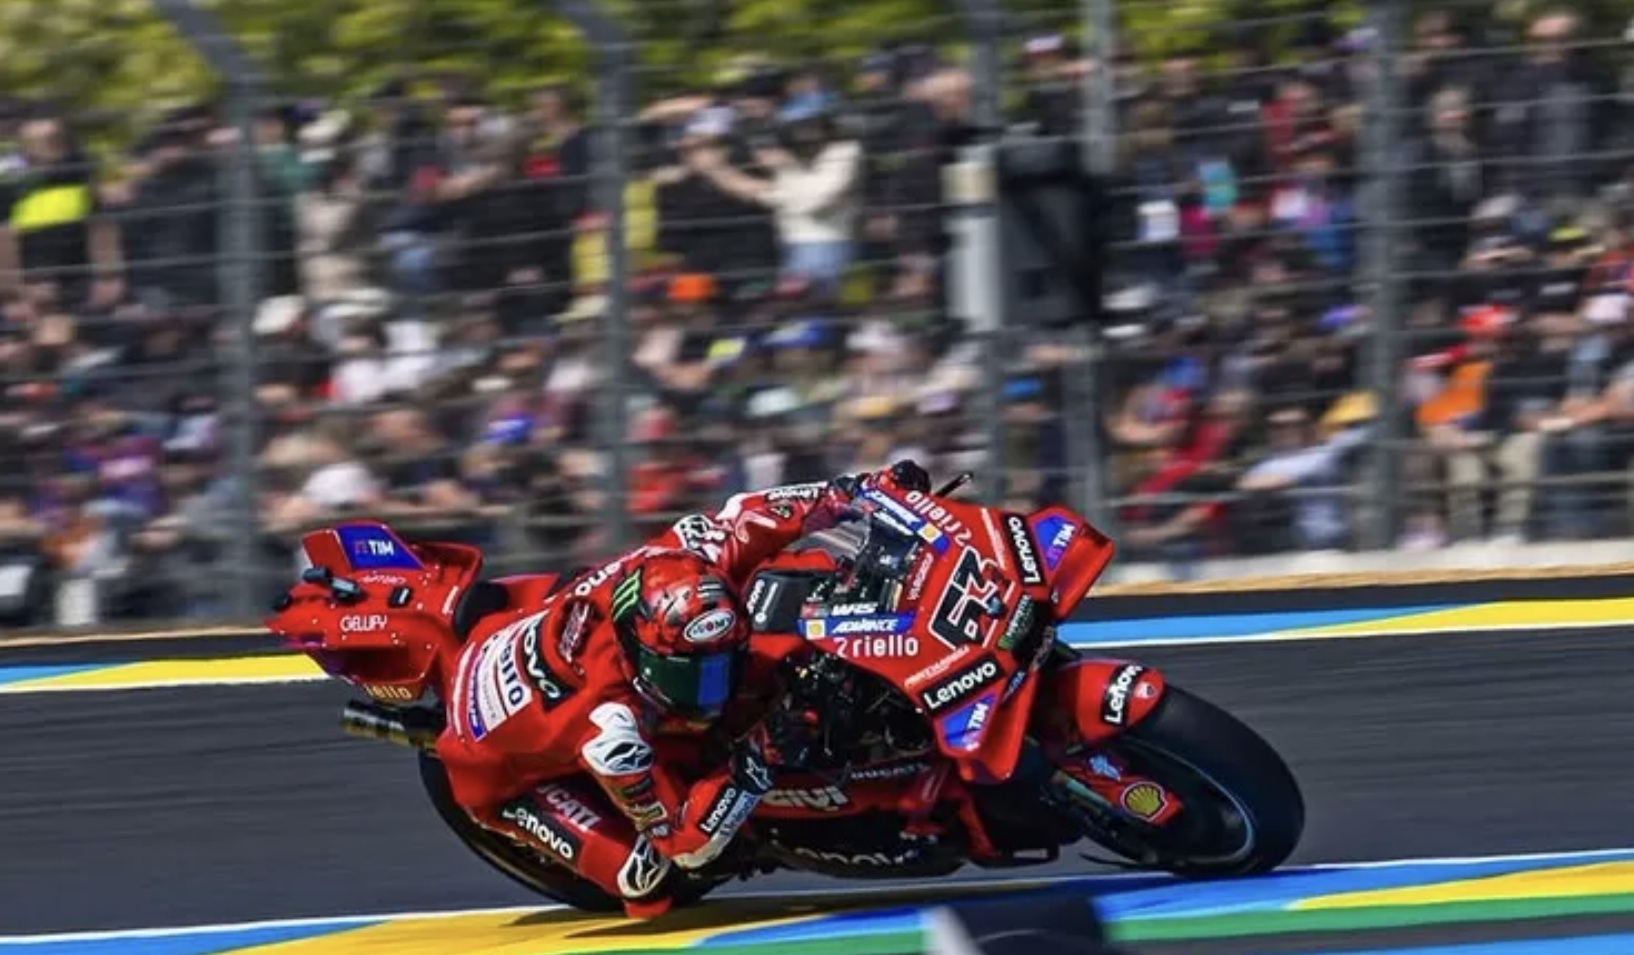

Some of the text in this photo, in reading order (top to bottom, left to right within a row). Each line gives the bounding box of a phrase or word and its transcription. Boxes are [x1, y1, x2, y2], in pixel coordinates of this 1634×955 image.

[368, 540, 394, 556] TIM
[1008, 517, 1041, 583] Lenovo
[928, 545, 1015, 651] 63
[923, 662, 997, 710] Lenovo
[967, 702, 989, 731] TIM
[701, 787, 736, 832] Lenovo
